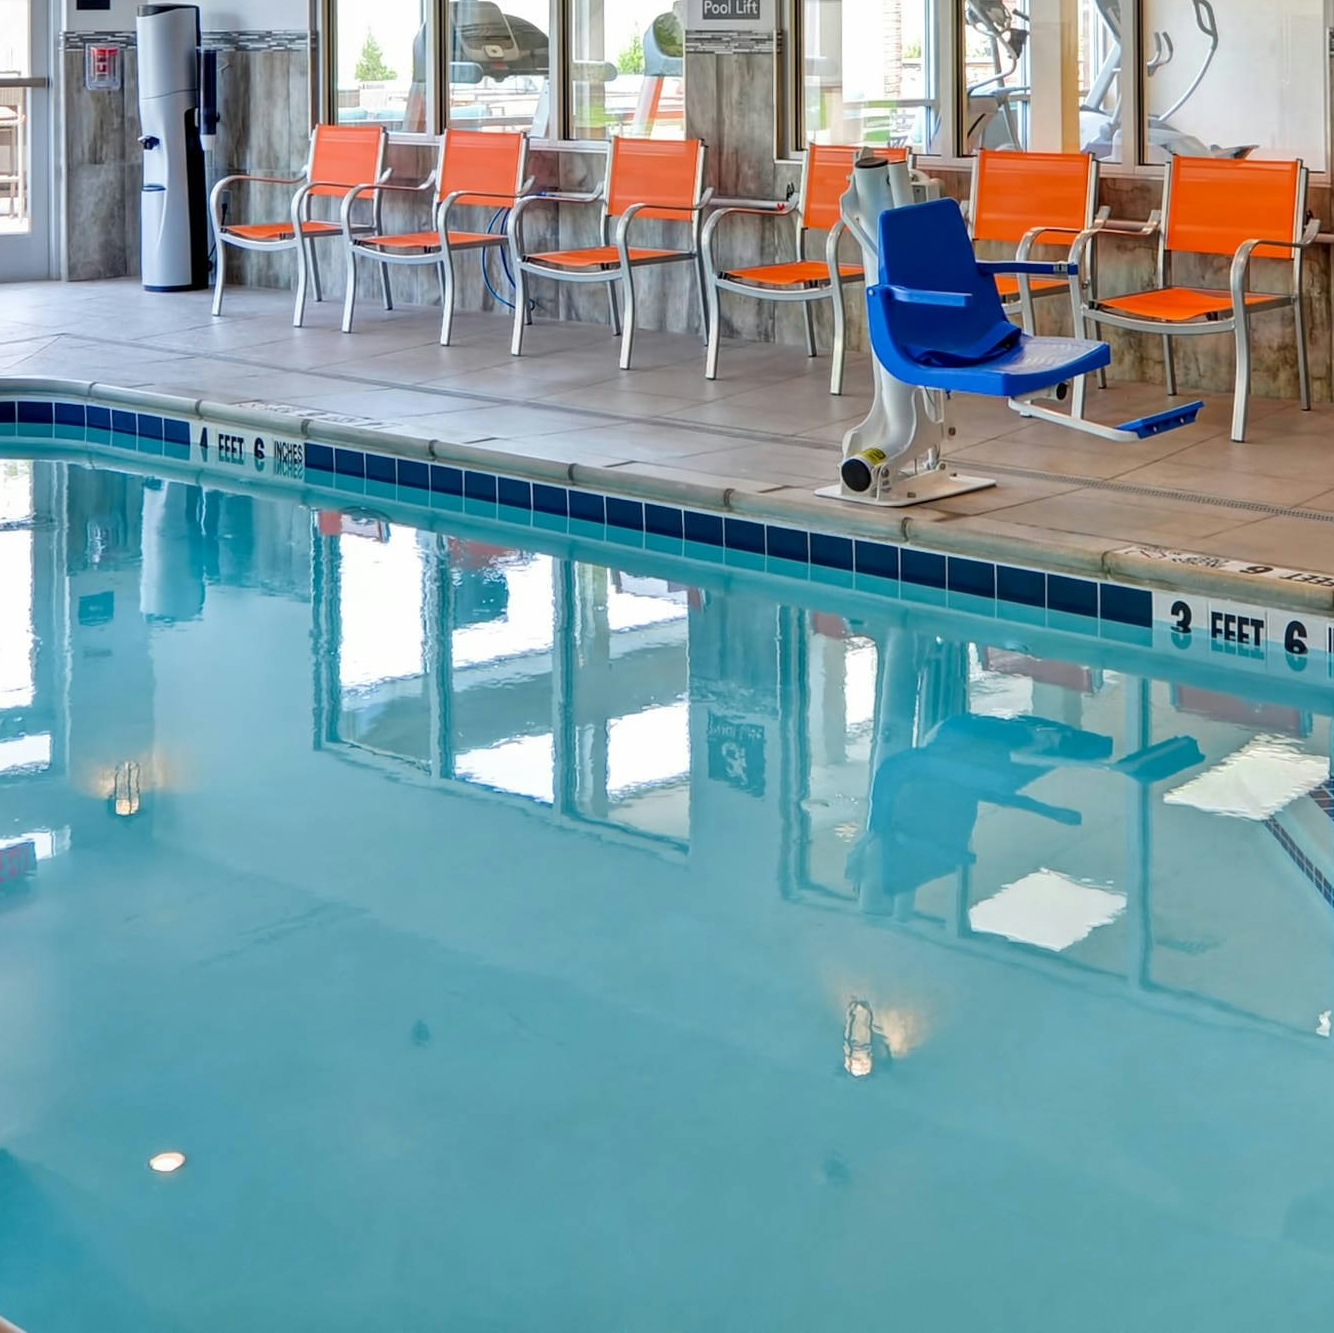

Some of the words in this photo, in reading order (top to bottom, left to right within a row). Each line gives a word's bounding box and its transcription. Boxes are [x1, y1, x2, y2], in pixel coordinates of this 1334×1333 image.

[704, 0, 731, 15] Pool
[218, 433, 244, 455] FEET
[254, 437, 265, 459] 6
[274, 440, 303, 465] INCHES
[1170, 600, 1192, 634] 3
[1211, 611, 1265, 647] FEET
[1284, 620, 1308, 655] 6
